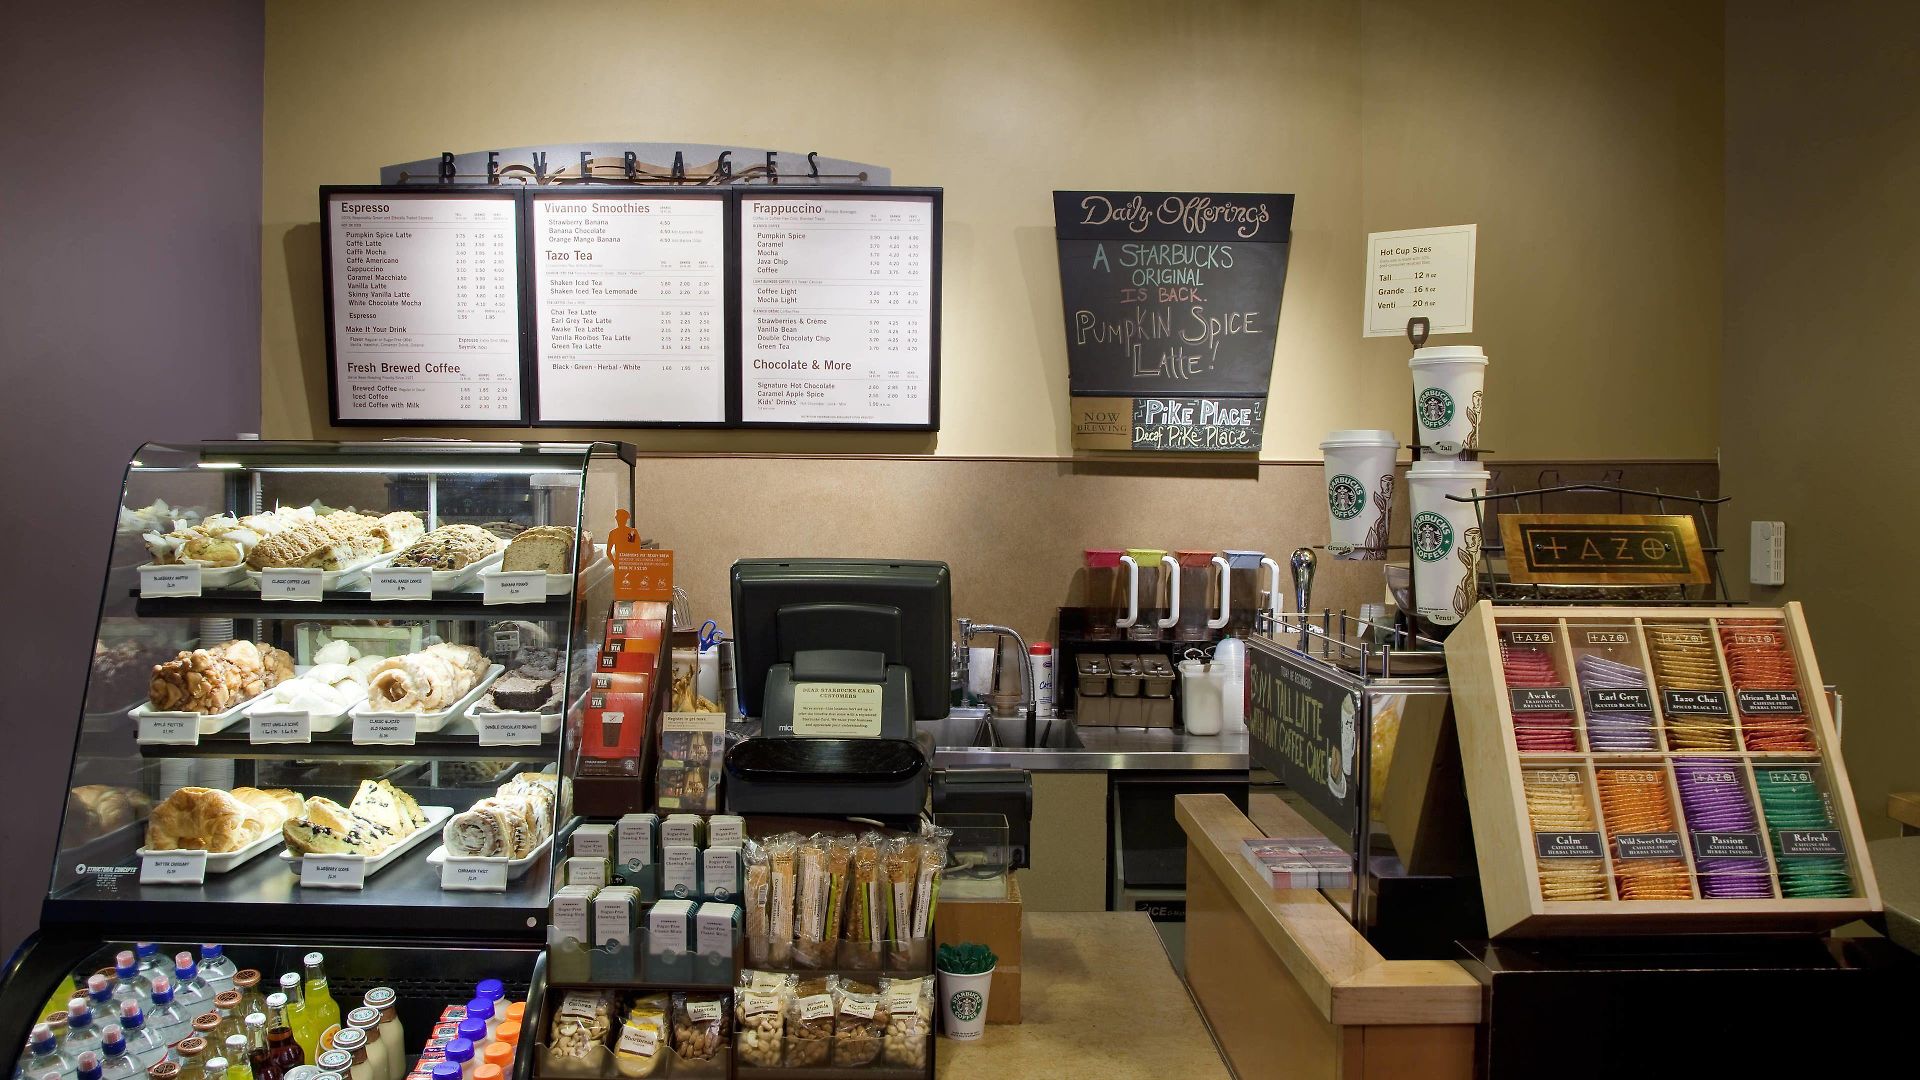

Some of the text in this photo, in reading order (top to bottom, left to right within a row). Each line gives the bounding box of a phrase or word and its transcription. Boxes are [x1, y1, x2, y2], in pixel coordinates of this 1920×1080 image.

[442, 152, 818, 178] BEVERAGES
[342, 202, 390, 214] Espresso
[544, 203, 587, 213] Vivanno
[592, 203, 650, 213] Smoothies
[753, 203, 822, 215] Frappuccino
[1080, 195, 1270, 238] Daily Offerings
[545, 250, 592, 261] Tazo Tea
[1092, 243, 1110, 273] A
[1132, 267, 1204, 287] ORIGINAL
[1120, 288, 1148, 304] IS
[348, 362, 461, 373] Fresh Brewed Coffee
[753, 359, 852, 370] Chocolate & More
[1419, 390, 1451, 407] STARBUCKS
[1084, 412, 1120, 421] NOW
[1422, 417, 1448, 428] COFFEE
[1133, 426, 1164, 444] Decaf
[1206, 426, 1250, 446] Place
[1329, 475, 1363, 496] STARBUCKS
[1332, 506, 1359, 519] COFFEE
[1413, 512, 1451, 535] STARBUCKS
[1416, 548, 1446, 562] COFFEE
[1618, 693, 1639, 702] Grey
[1697, 694, 1718, 703] Chai
[1275, 678, 1294, 724] TALL
[1296, 690, 1323, 741] LATTE
[1279, 722, 1304, 768] COFFEE
[1556, 836, 1581, 844] Calm
[1712, 836, 1743, 844] Passion
[952, 990, 983, 1003] STARBUCKS
[954, 1011, 980, 1021] COFFEE
